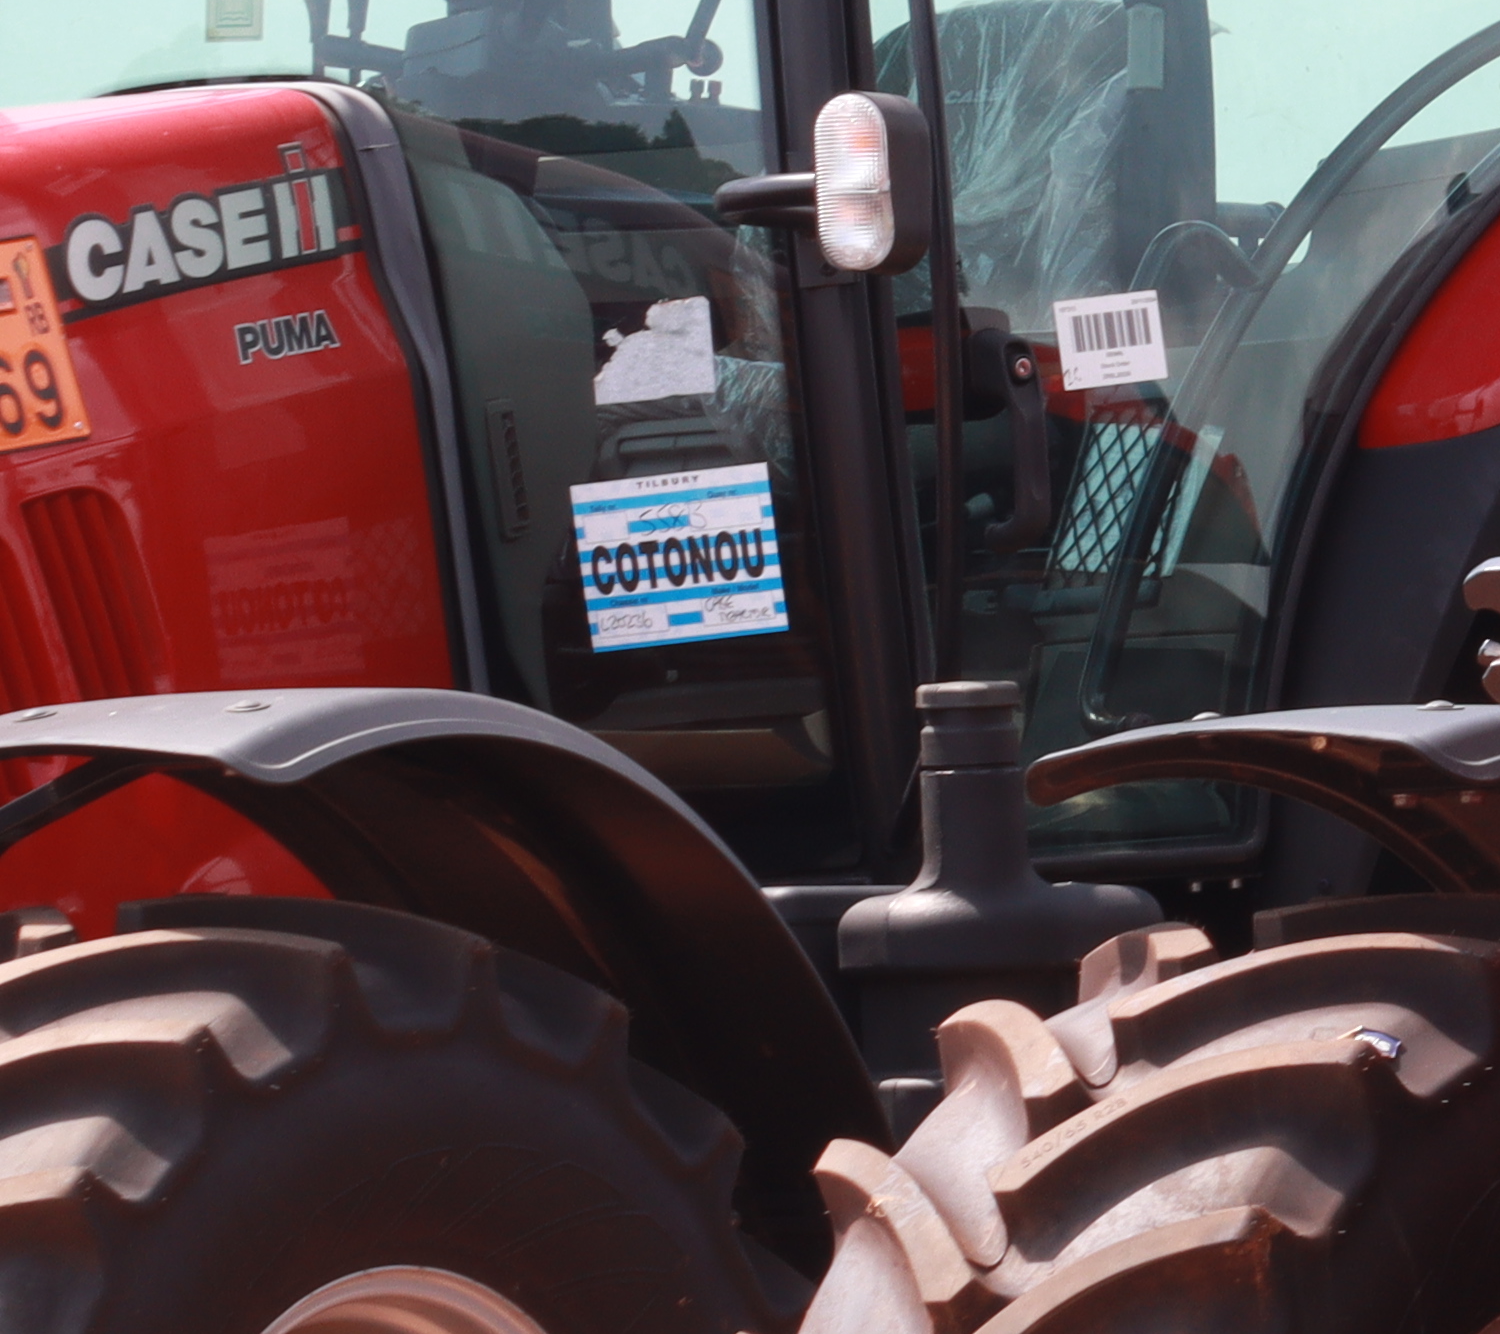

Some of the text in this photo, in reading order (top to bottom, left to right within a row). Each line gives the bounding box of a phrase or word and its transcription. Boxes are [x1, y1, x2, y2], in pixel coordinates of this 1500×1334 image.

[235, 309, 340, 365] PUMA
[636, 474, 701, 490] TILBURY
[591, 527, 765, 596] COTONOU
